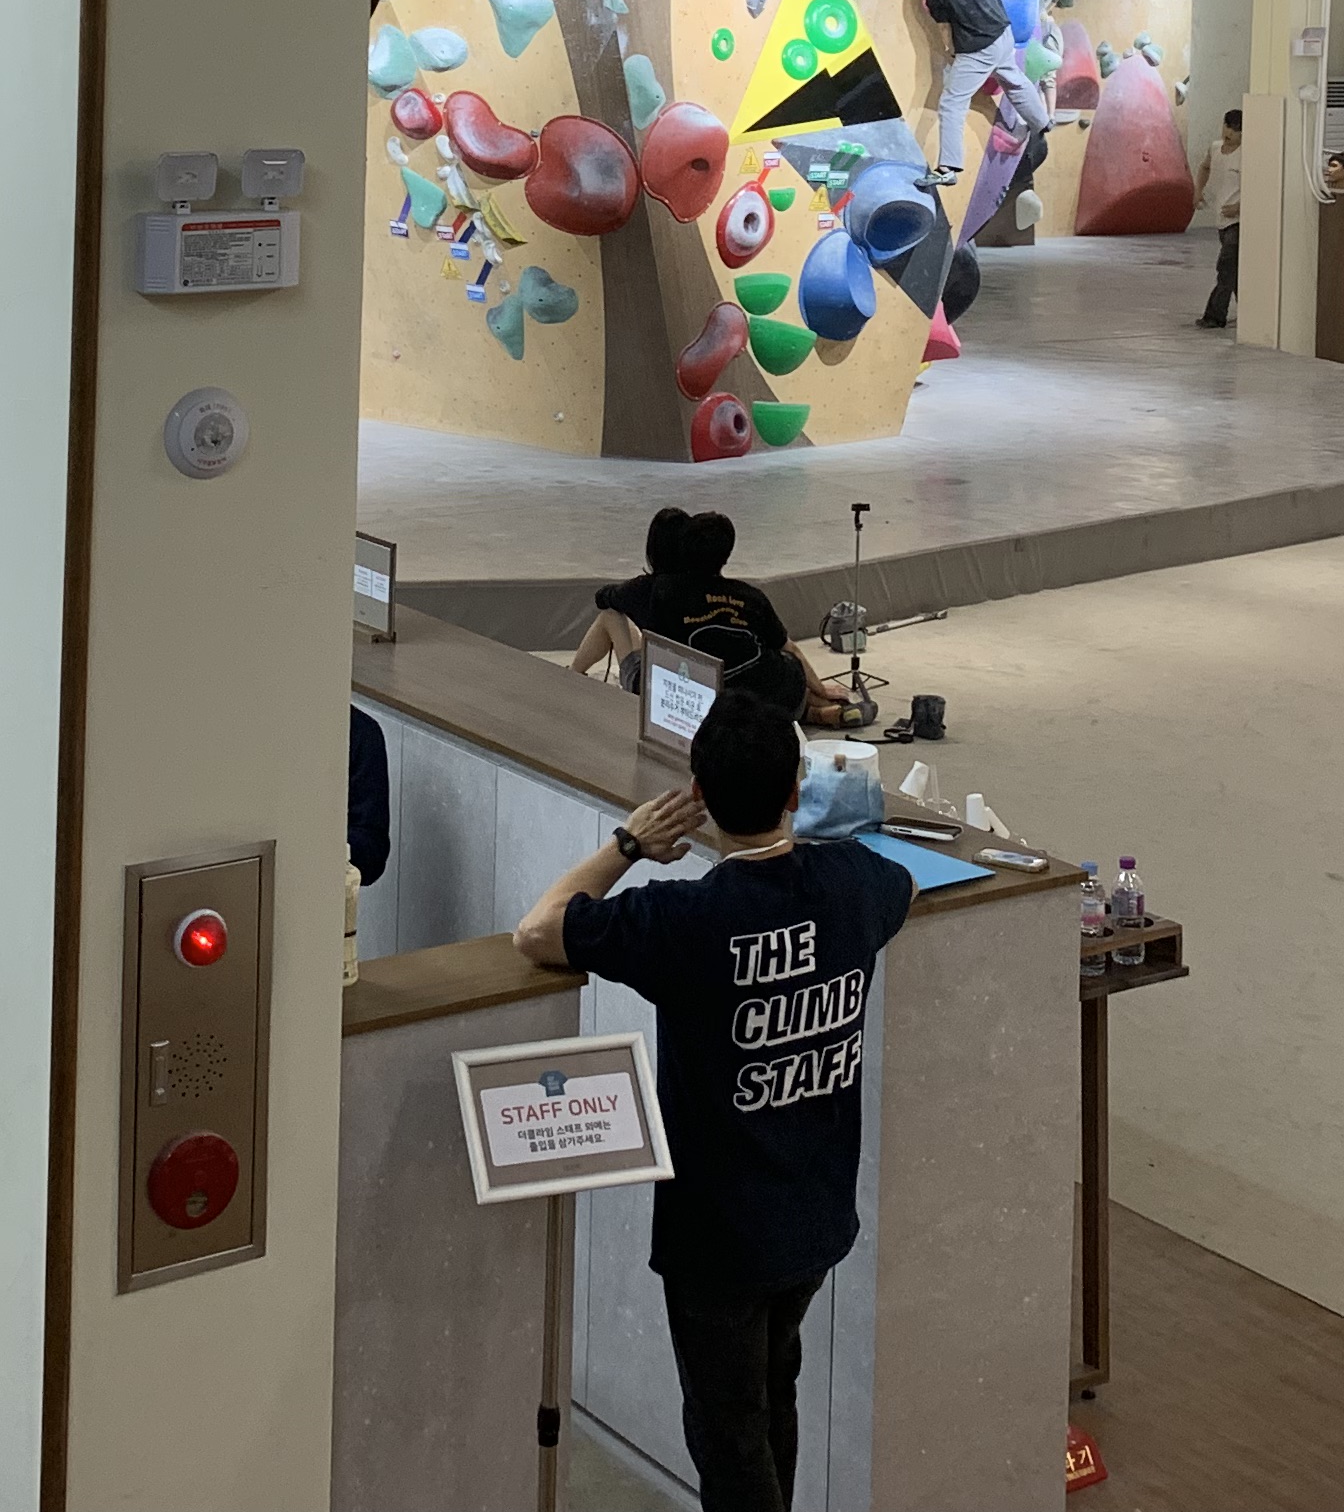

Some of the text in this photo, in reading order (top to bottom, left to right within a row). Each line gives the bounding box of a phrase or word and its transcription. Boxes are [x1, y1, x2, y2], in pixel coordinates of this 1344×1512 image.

[730, 920, 816, 986] THE
[732, 968, 865, 1050] CLIMB
[733, 1030, 862, 1112] STAFF
[500, 1094, 619, 1125] STAFF ONLY
[517, 1126, 554, 1140] 더클라임
